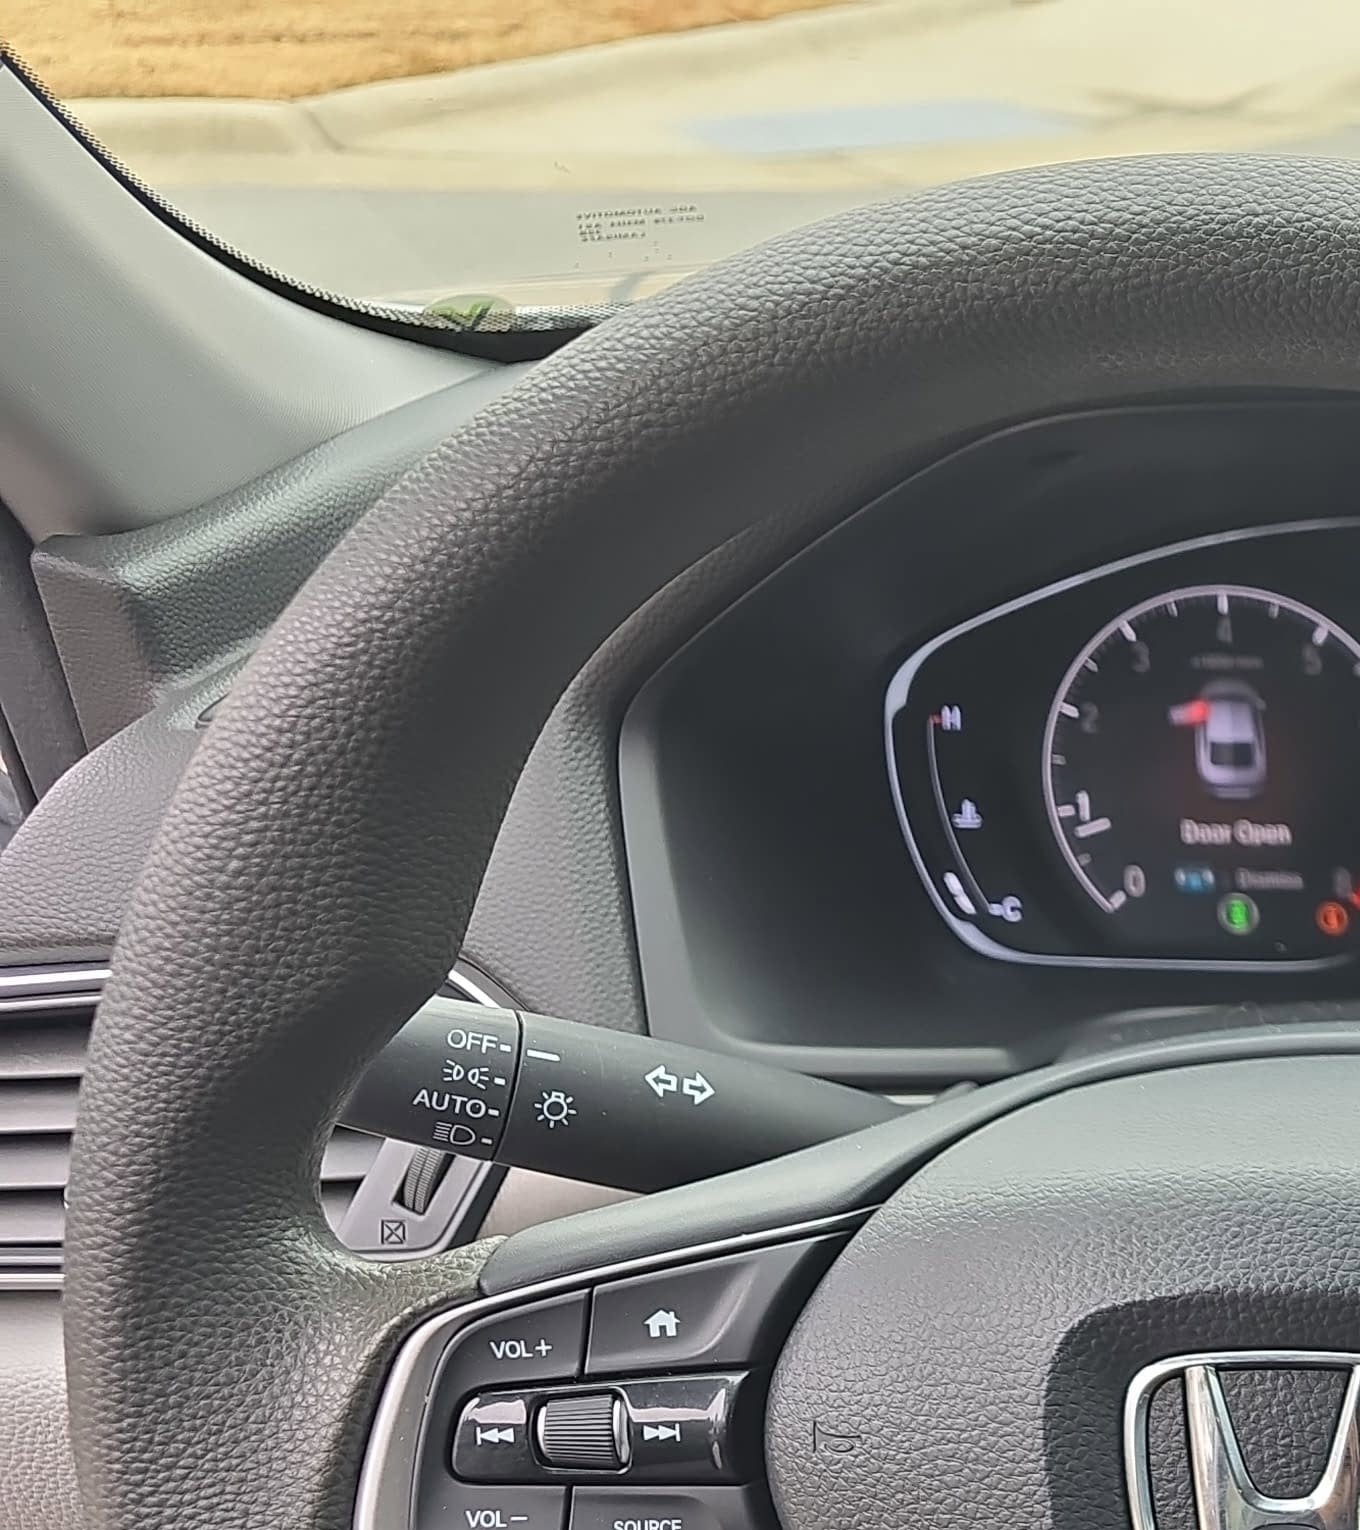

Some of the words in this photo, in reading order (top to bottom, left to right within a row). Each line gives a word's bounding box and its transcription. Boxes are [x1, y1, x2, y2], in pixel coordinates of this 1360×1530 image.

[1123, 864, 1147, 898] 0
[446, 1028, 499, 1055] OFF
[412, 1088, 487, 1120] AUTO
